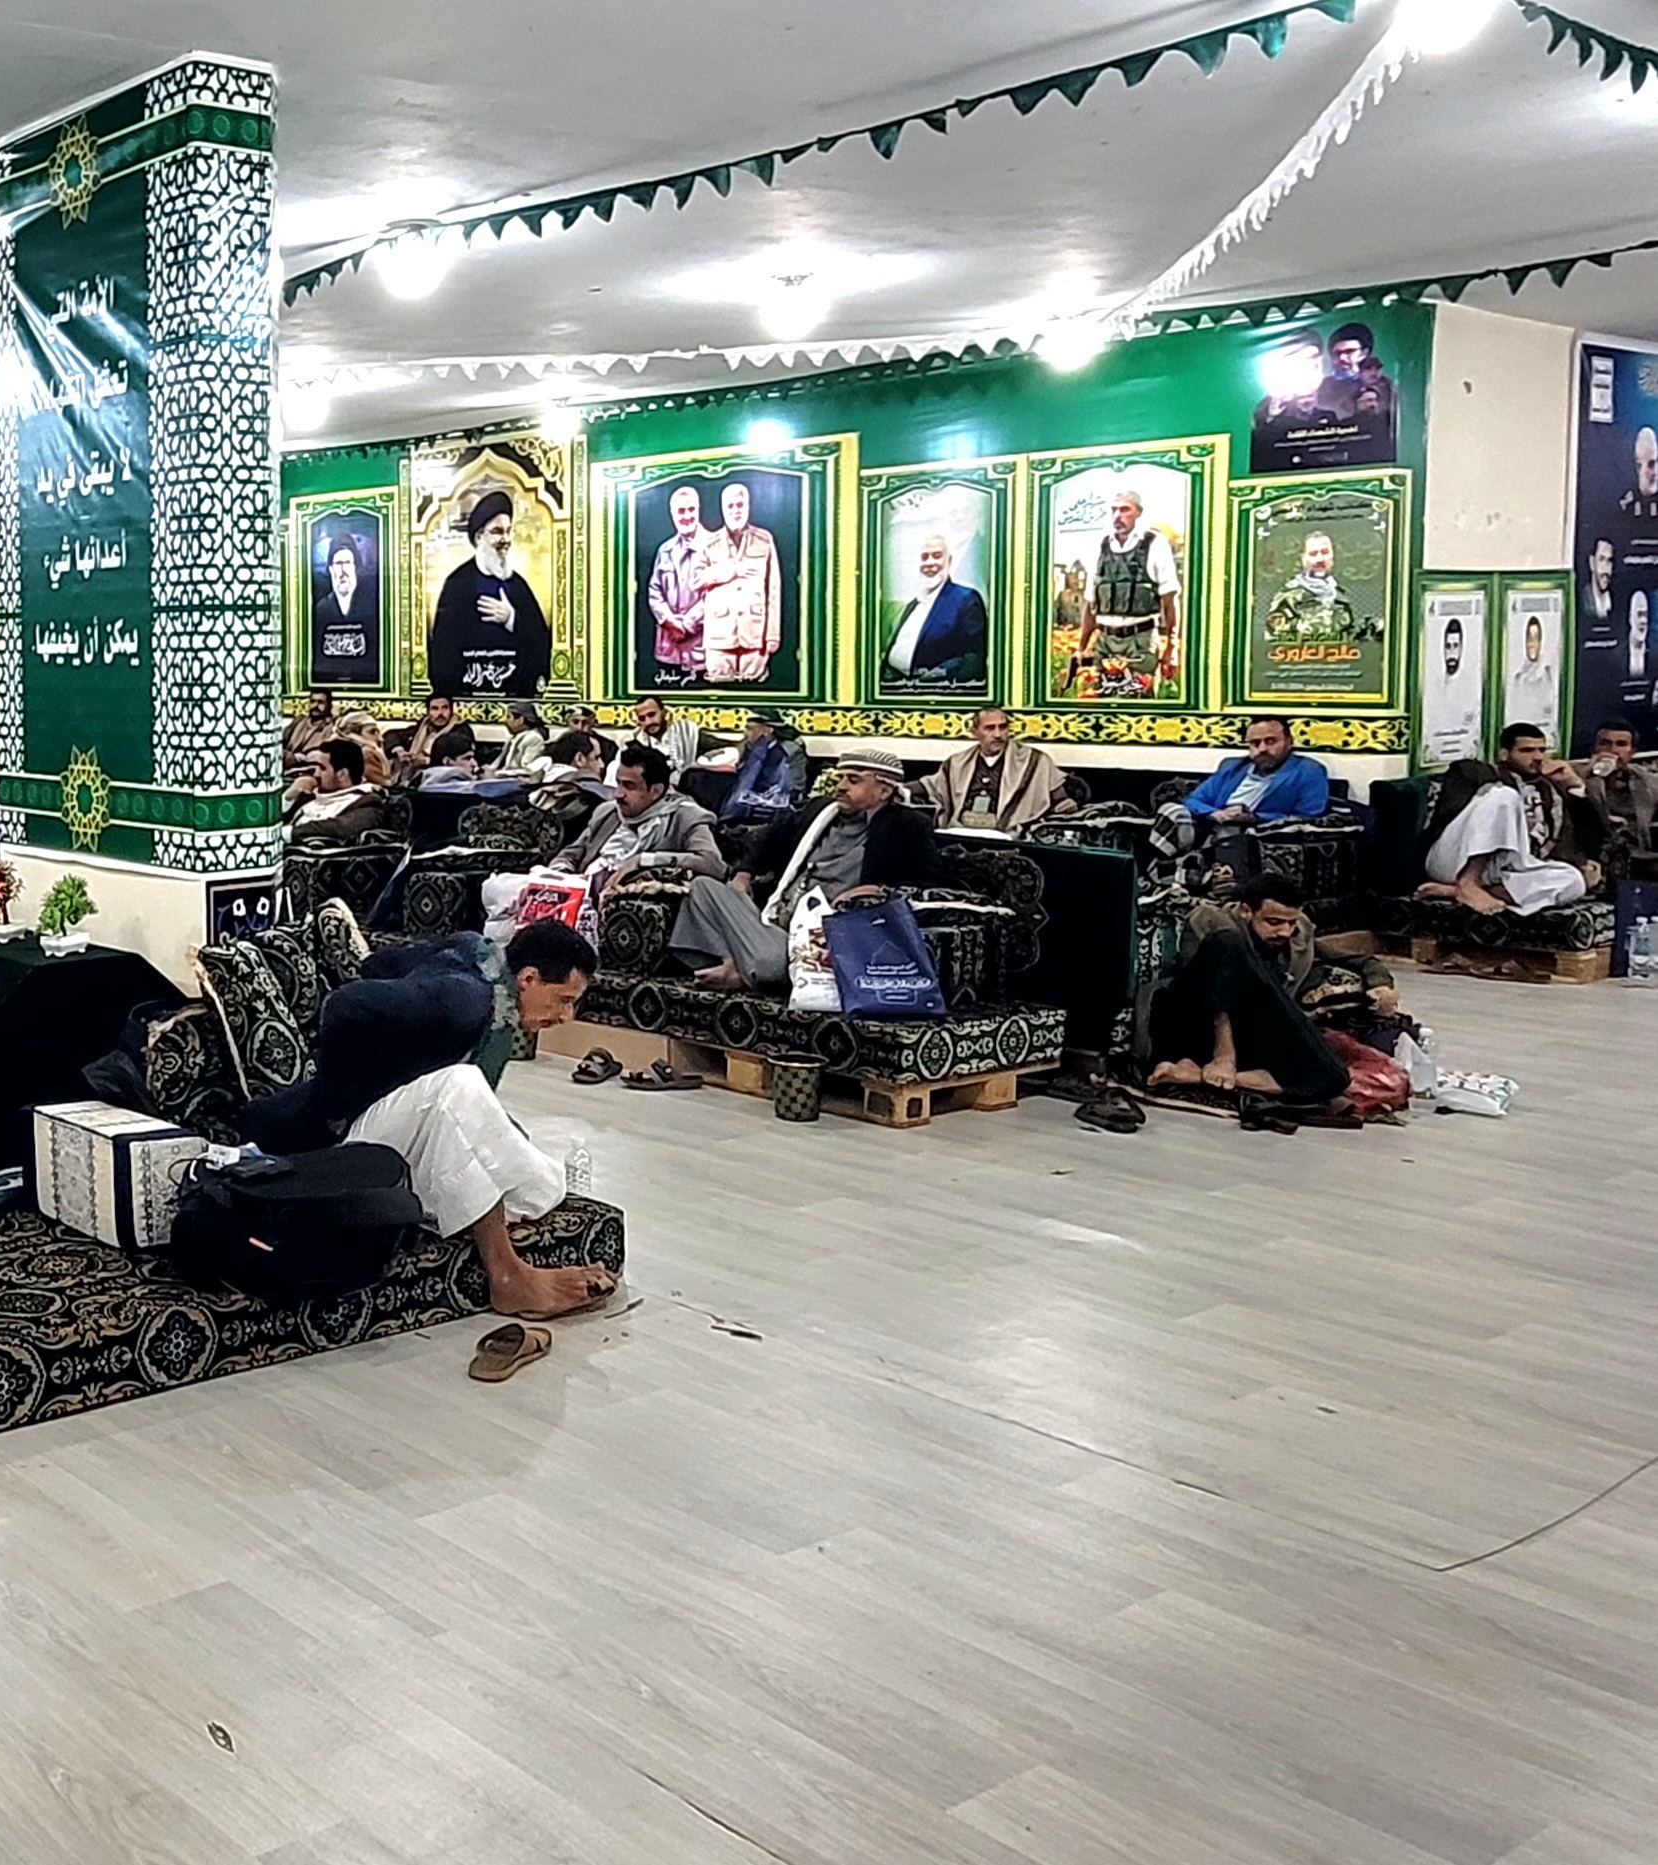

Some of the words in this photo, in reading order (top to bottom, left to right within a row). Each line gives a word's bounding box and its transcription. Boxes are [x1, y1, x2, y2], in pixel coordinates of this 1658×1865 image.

[56, 452, 76, 507] في
[120, 447, 132, 482] لا
[43, 534, 72, 590] شيء
[83, 615, 99, 664] أن
[103, 617, 140, 667] يمكن
